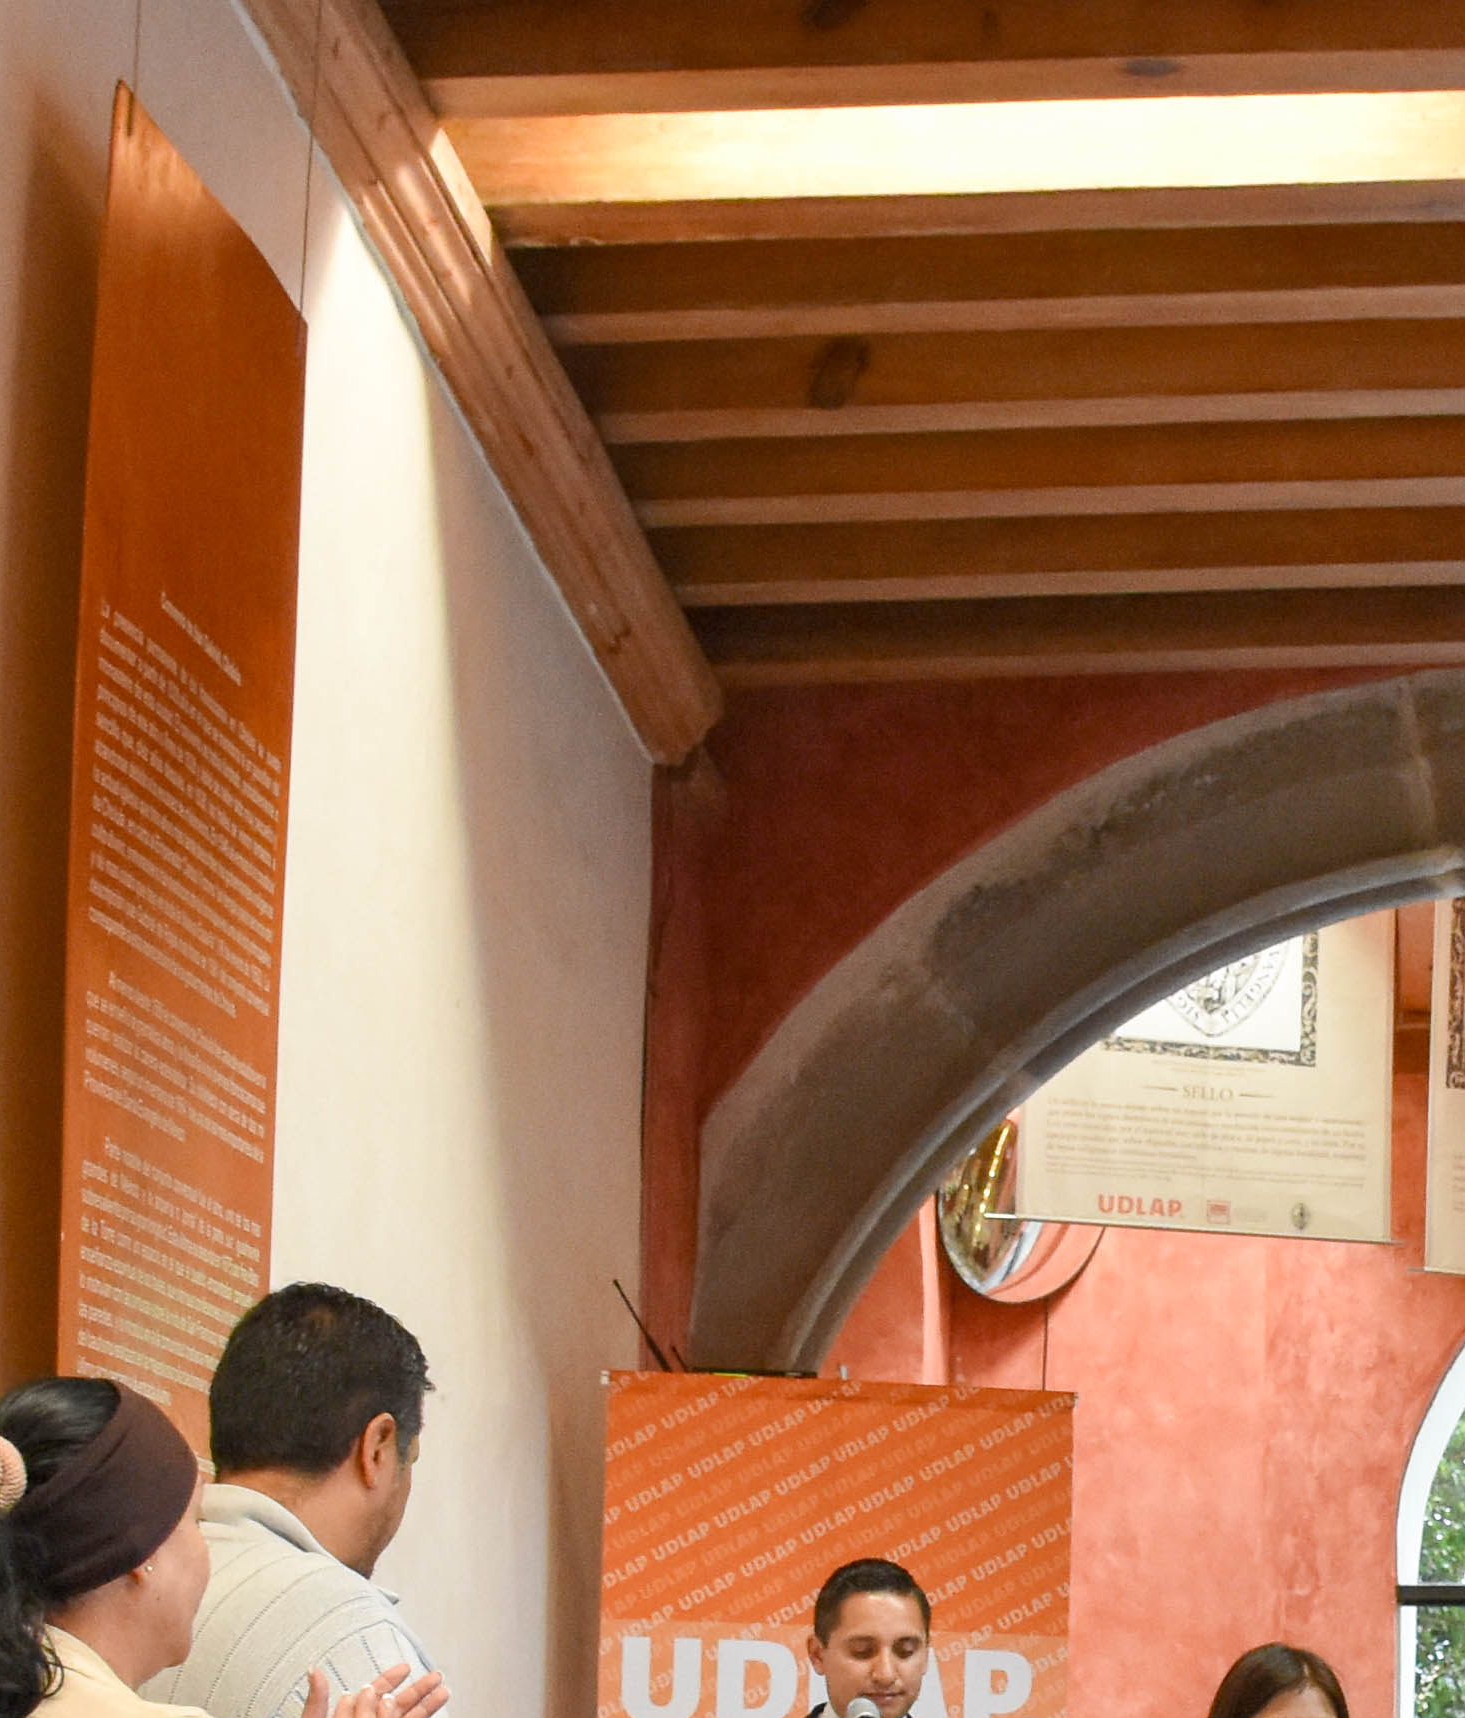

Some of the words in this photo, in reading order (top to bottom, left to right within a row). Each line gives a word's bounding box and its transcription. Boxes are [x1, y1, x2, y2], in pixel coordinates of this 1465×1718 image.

[1182, 1084, 1233, 1101] SELLO
[1097, 1194, 1182, 1217] UDLAP
[603, 1557, 649, 1589] DLAP
[925, 1575, 968, 1606] DLAP
